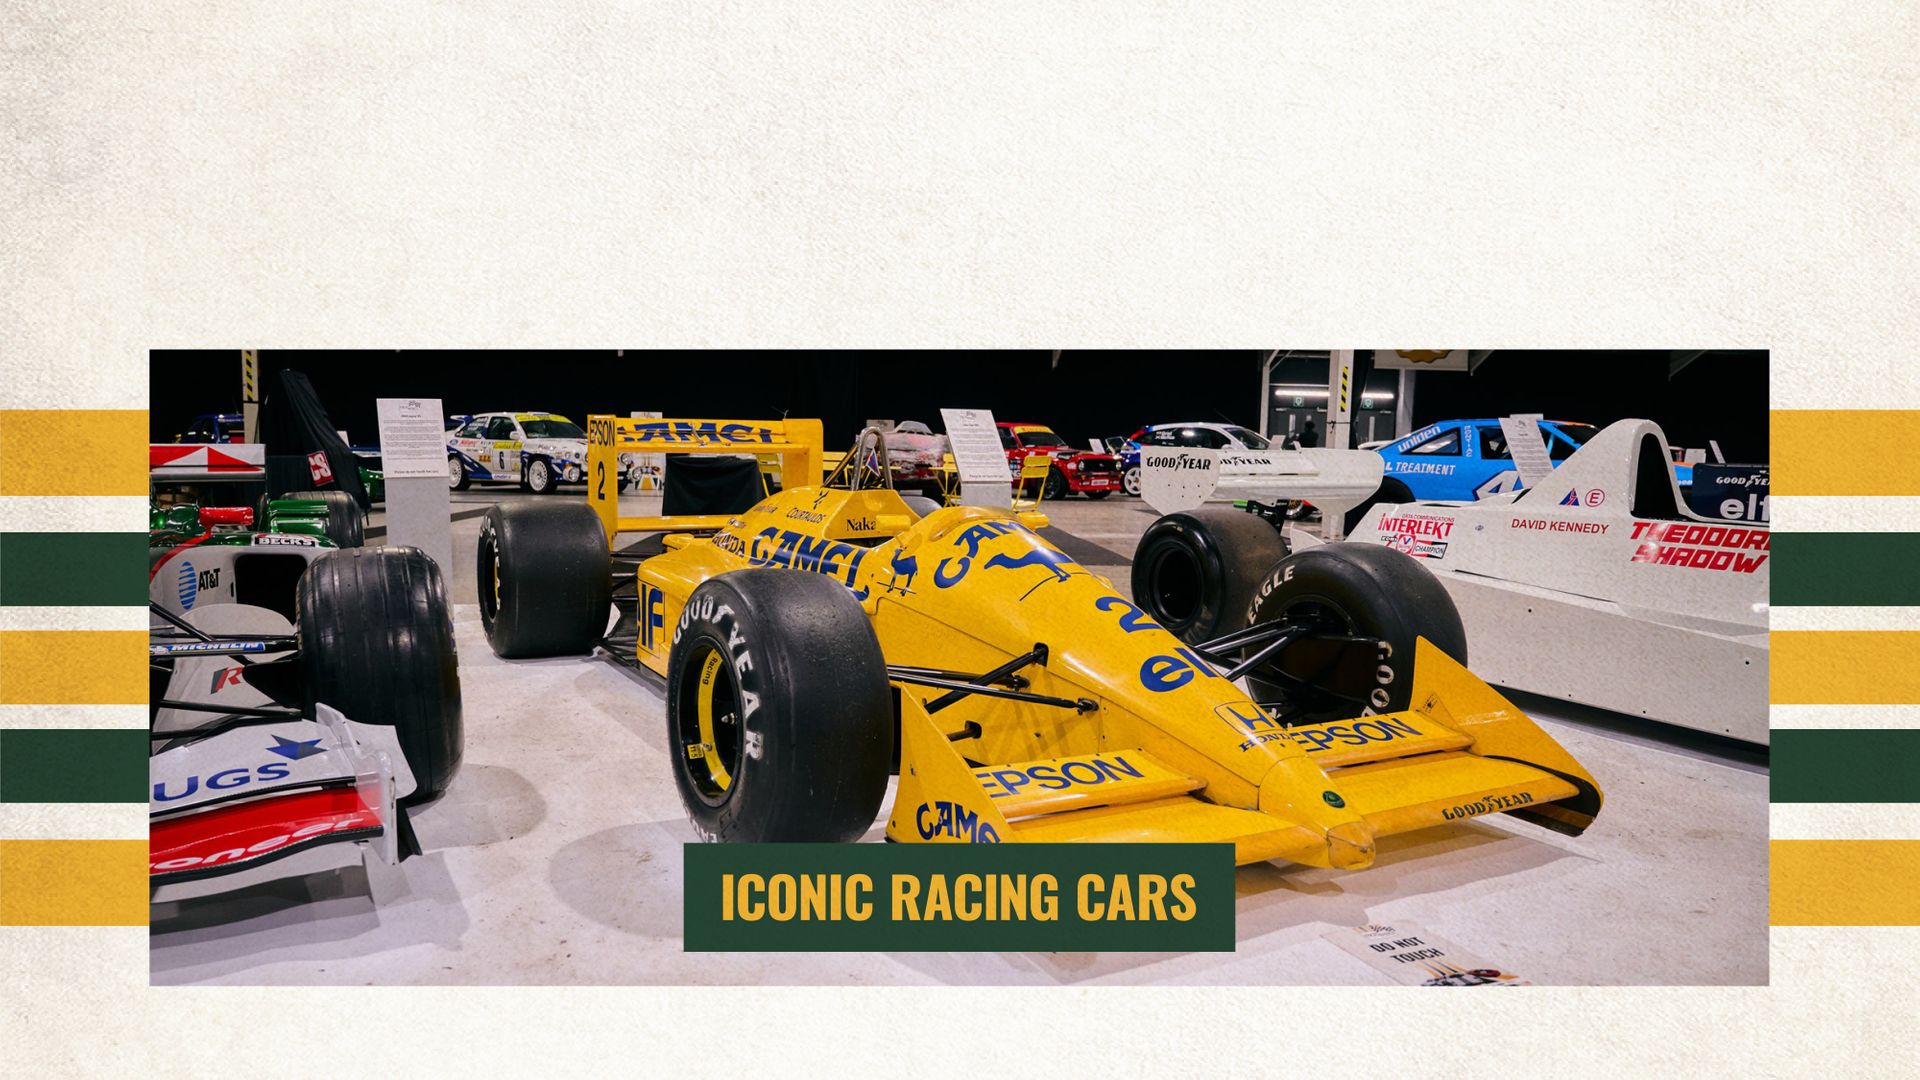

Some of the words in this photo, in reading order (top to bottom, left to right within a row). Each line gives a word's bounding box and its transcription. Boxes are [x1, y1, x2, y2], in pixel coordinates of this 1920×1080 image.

[590, 420, 615, 446] EPSON
[597, 461, 606, 500] 2
[1396, 462, 1457, 476] TREATMENT
[1512, 519, 1547, 530] DAVID
[1549, 521, 1609, 535] KENNEDY
[1415, 544, 1444, 554] CHAMPION
[1631, 545, 1768, 573] SHADOW
[198, 568, 221, 592] AT&T
[1247, 564, 1296, 625] EAGLE
[1095, 596, 1165, 633] 2
[172, 641, 258, 651] MICHELIN
[702, 656, 718, 686] Racing
[1291, 716, 1424, 752] EPSON
[154, 762, 290, 802] UGS
[975, 756, 1145, 798] EPSON
[1369, 942, 1396, 953] DO
[1392, 936, 1425, 948] NOT
[1389, 948, 1446, 963] TOUCH
